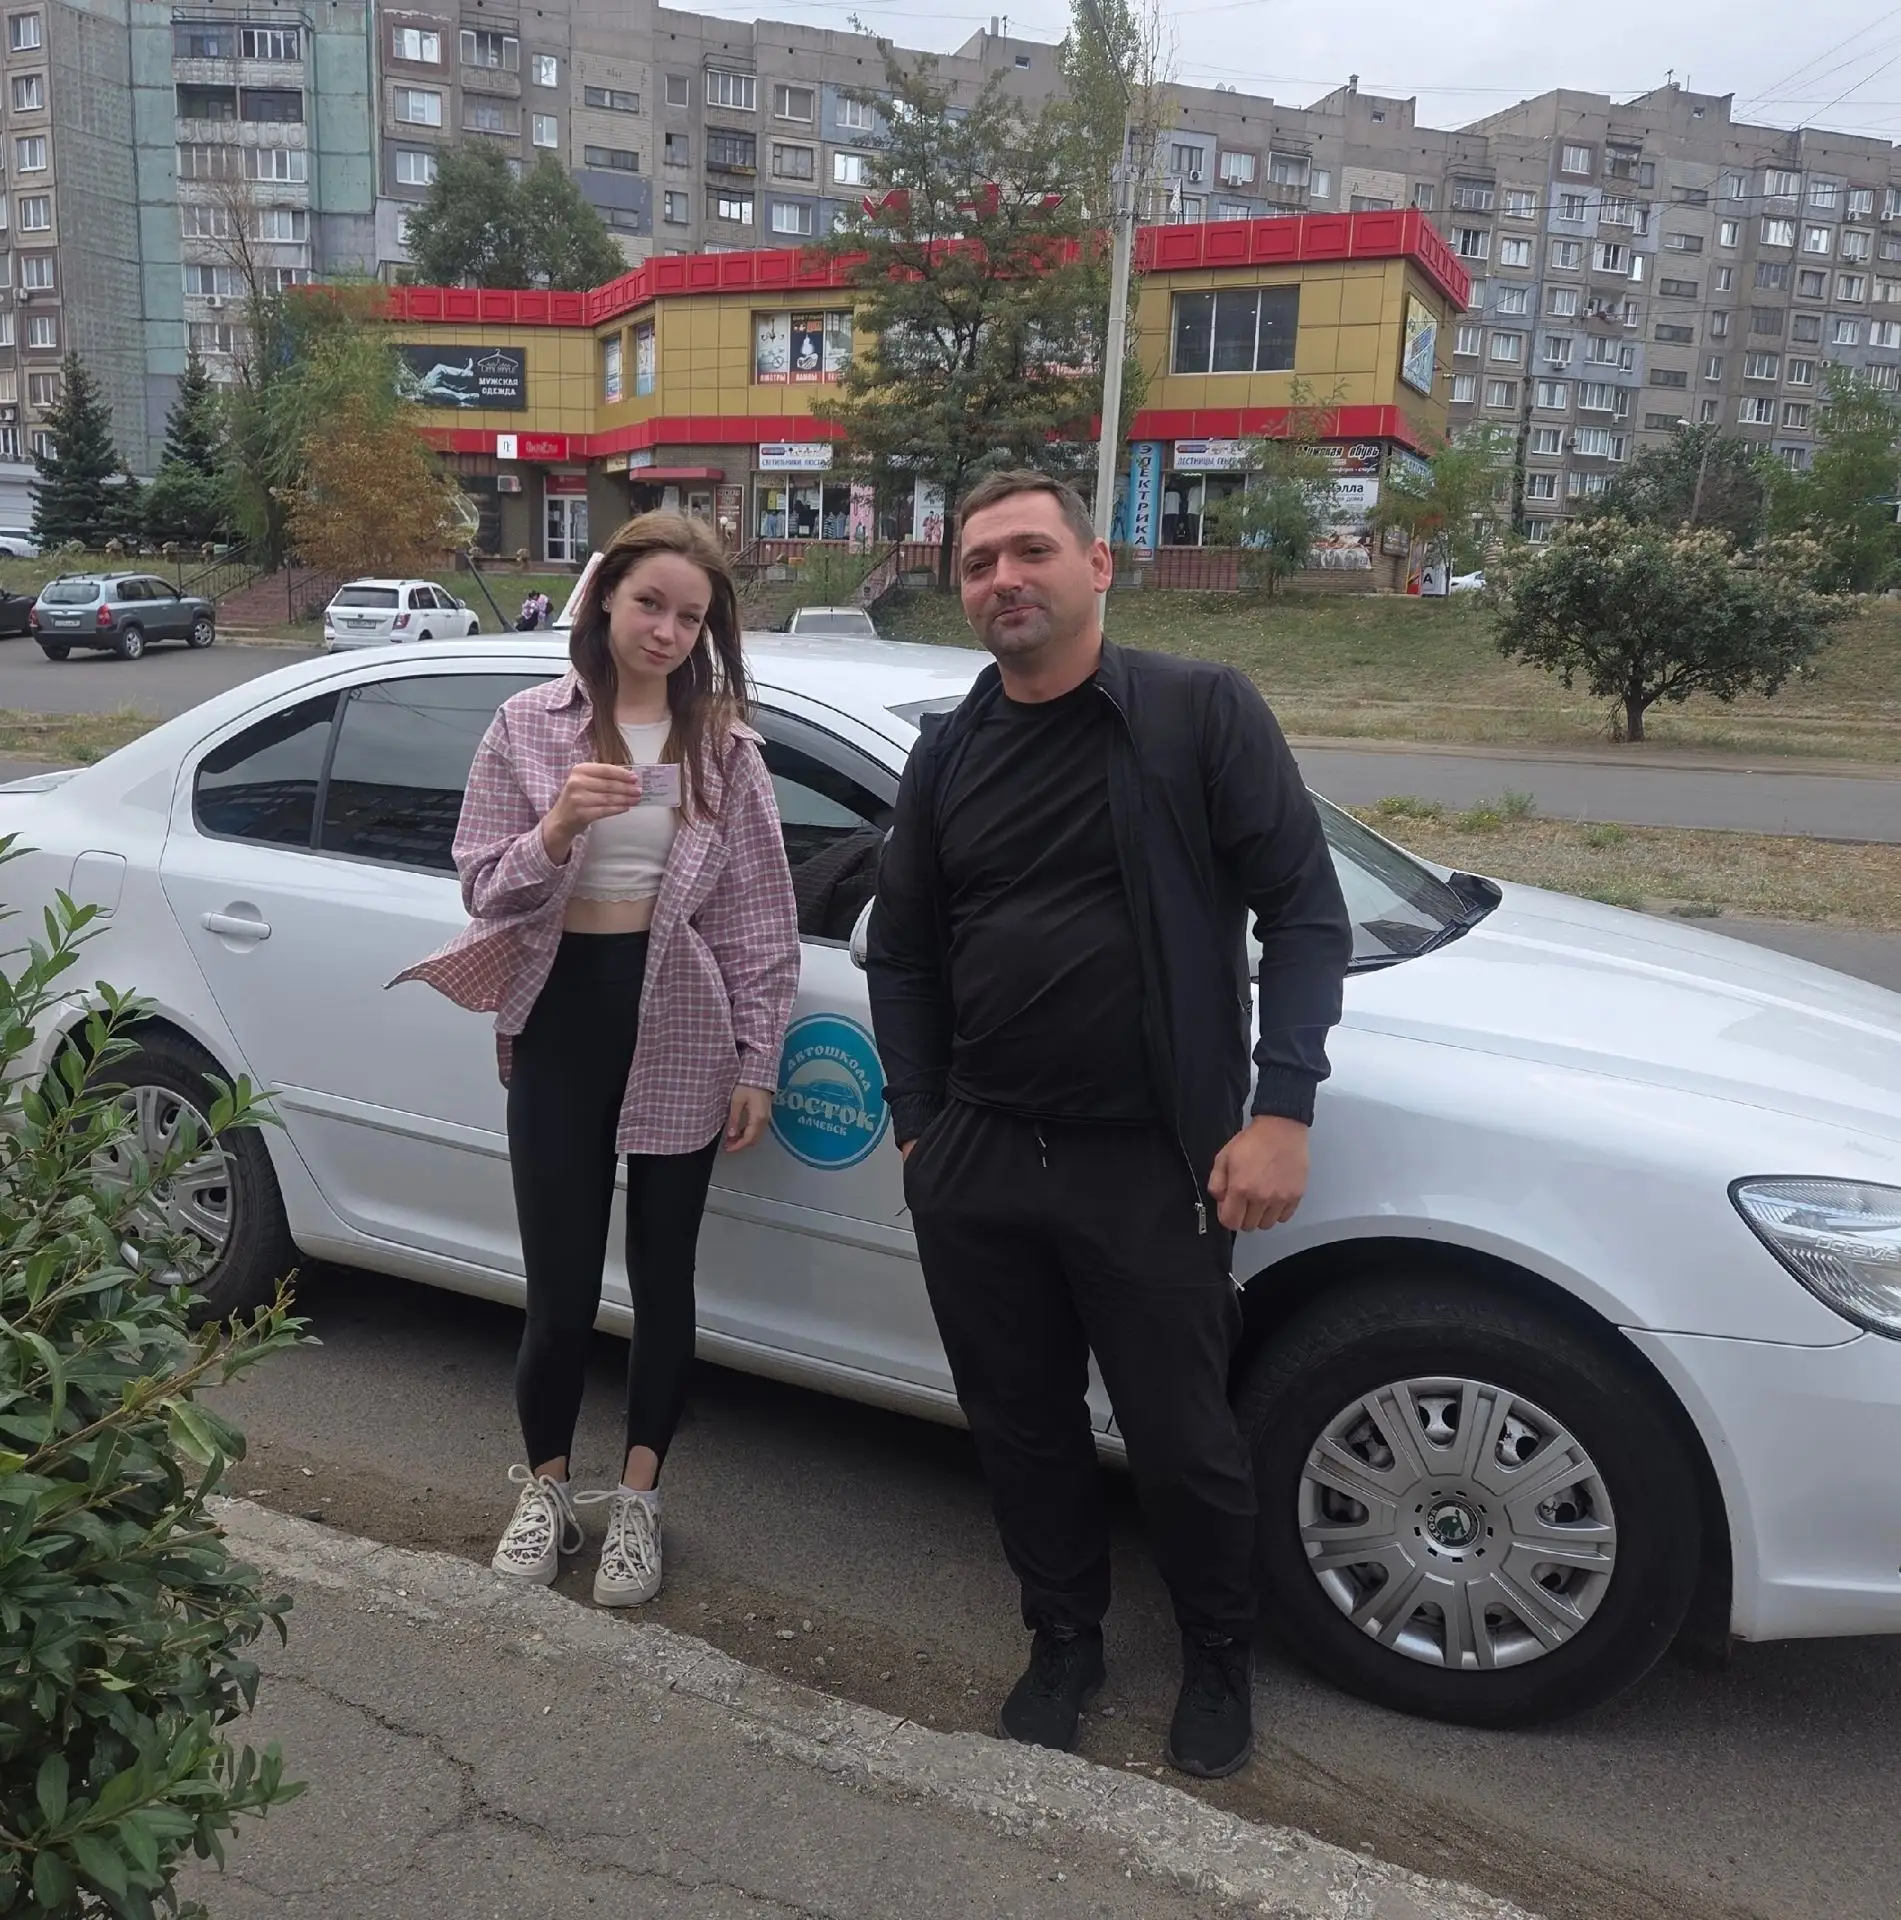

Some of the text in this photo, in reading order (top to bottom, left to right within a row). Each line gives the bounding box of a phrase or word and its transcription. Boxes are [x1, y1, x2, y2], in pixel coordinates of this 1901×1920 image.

[478, 377, 519, 386] МУЖСКАЯ
[481, 387, 517, 396] ОДЕЖДА
[1134, 445, 1153, 546] ЭЛЕКТРИКА
[787, 1045, 871, 1093] АВТОШКОЛА
[773, 1088, 877, 1132] ВОСТОК
[798, 1115, 848, 1137] АЛЧЕВСК
